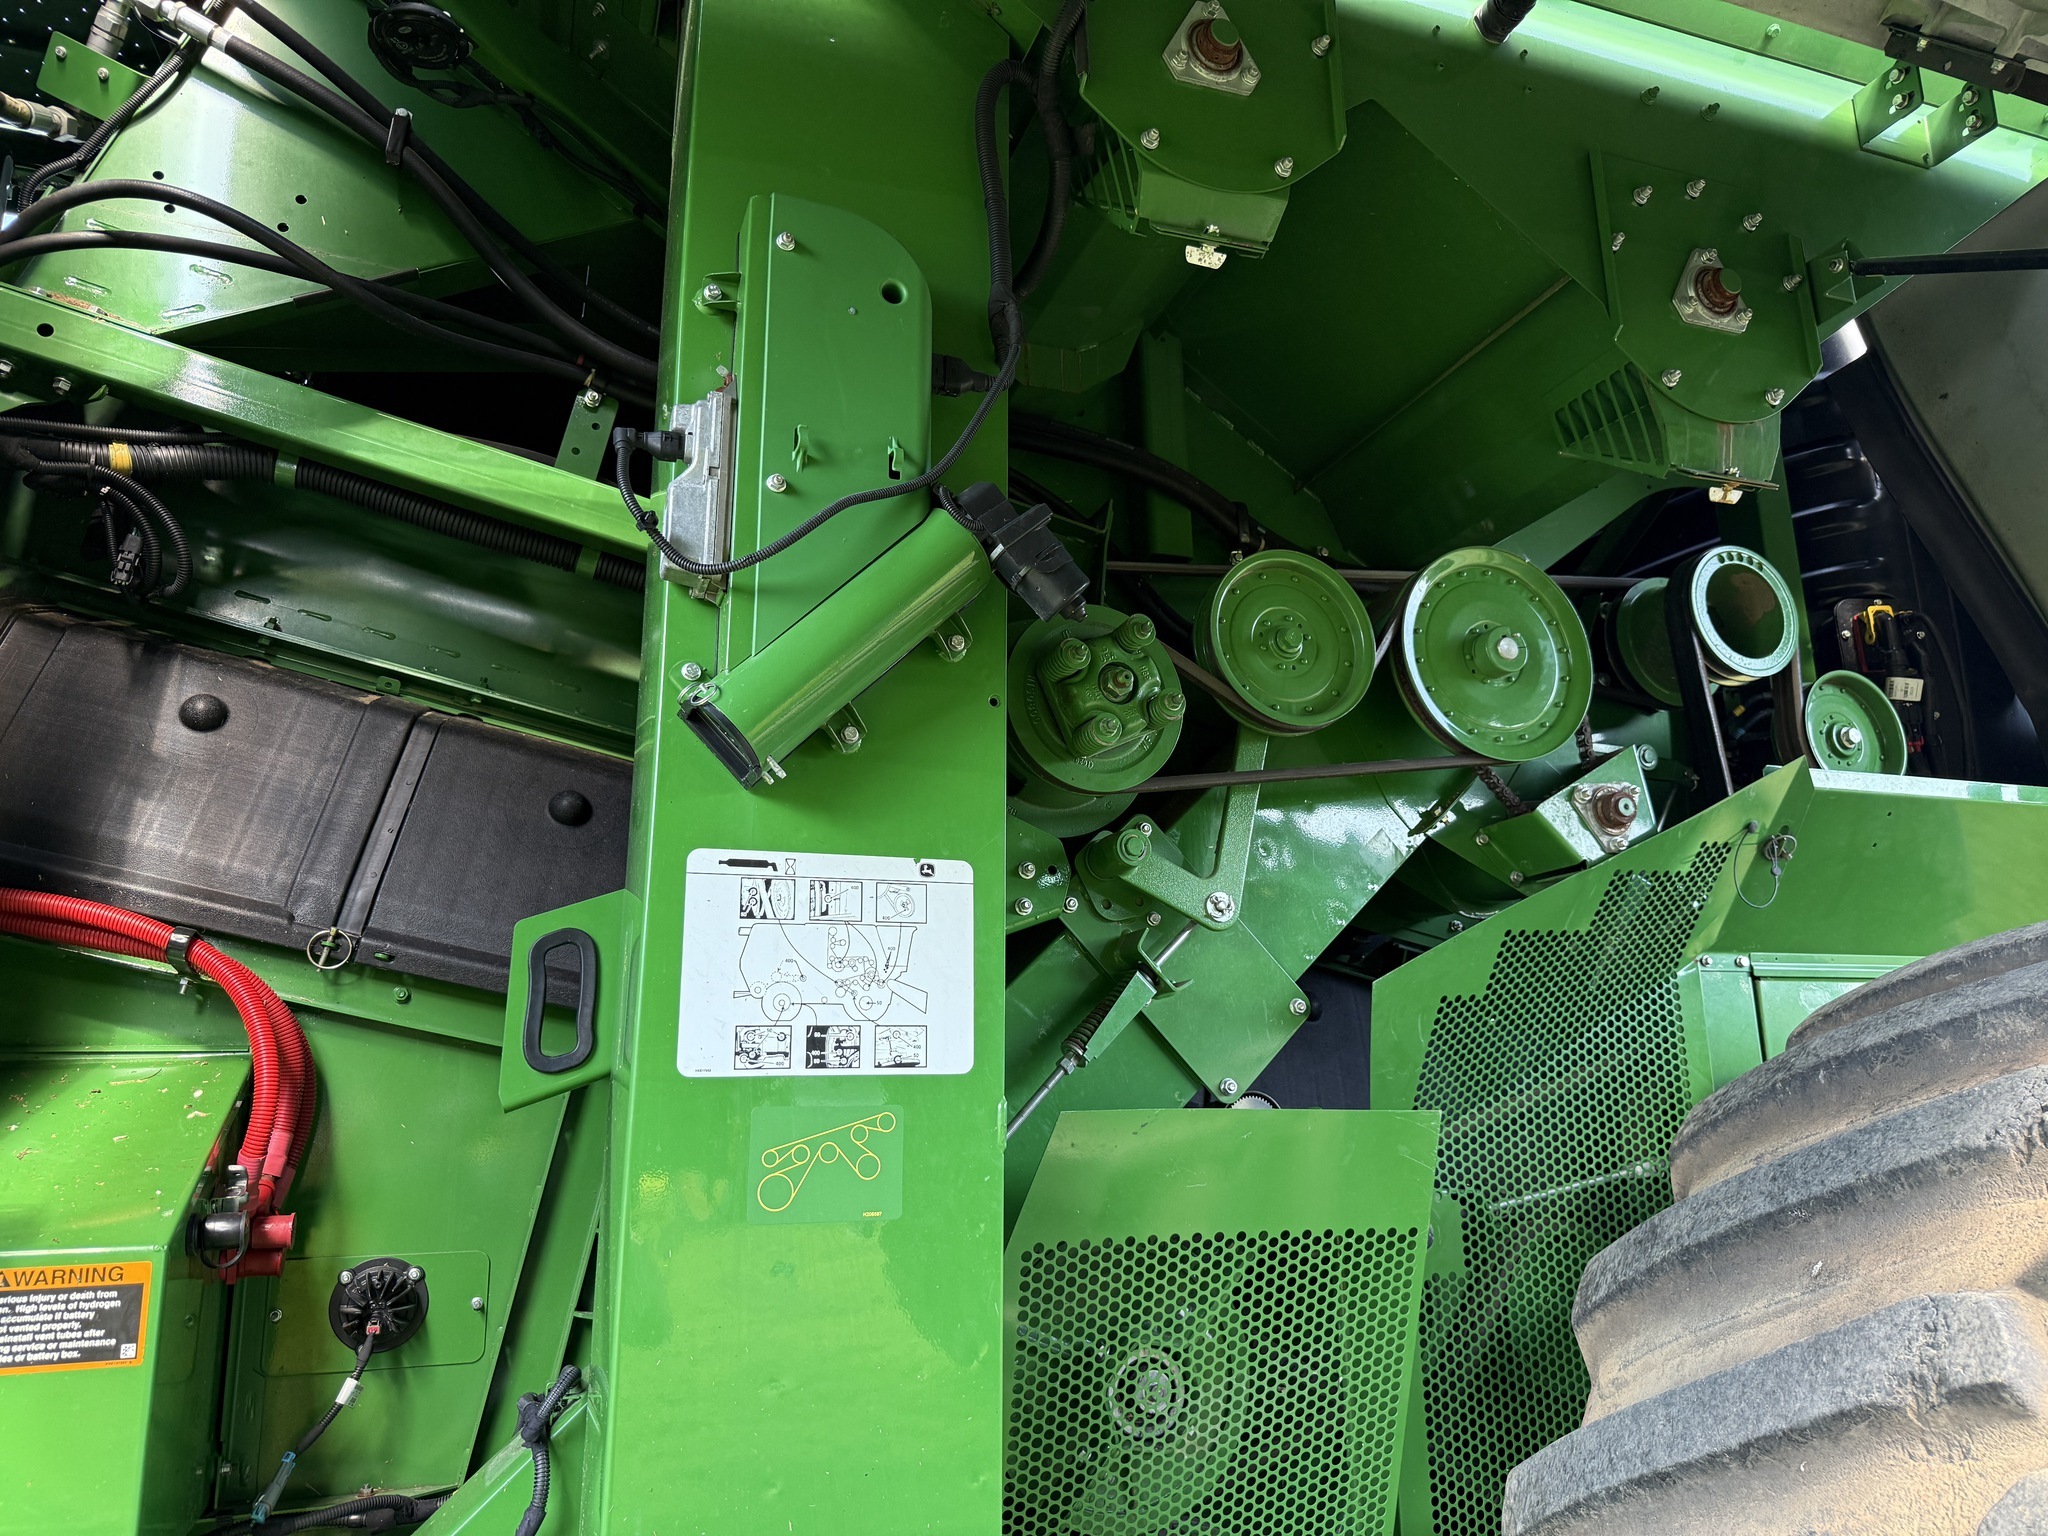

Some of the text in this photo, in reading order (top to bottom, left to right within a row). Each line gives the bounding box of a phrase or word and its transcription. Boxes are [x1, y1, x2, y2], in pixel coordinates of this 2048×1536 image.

[13, 1266, 125, 1287] WARNING
[29, 1292, 56, 1304] injury
[57, 1293, 69, 1301] or
[70, 1290, 95, 1300] death
[96, 1289, 118, 1299] from
[15, 1304, 38, 1315] High
[39, 1302, 66, 1312] levels
[67, 1301, 77, 1310] of
[79, 1299, 121, 1310] hydrogen
[1, 1310, 96, 1324] accumulate if battery
[9, 1323, 41, 1333] vented
[42, 1320, 82, 1332] properly.
[35, 1331, 55, 1341] vent
[56, 1330, 82, 1340] tubes
[83, 1329, 105, 1338] after
[11, 1343, 46, 1353] service
[46, 1342, 58, 1350] or
[59, 1338, 117, 1349] maintenance
[14, 1353, 26, 1362] or
[26, 1351, 60, 1362] battery
[61, 1349, 81, 1360] box.
